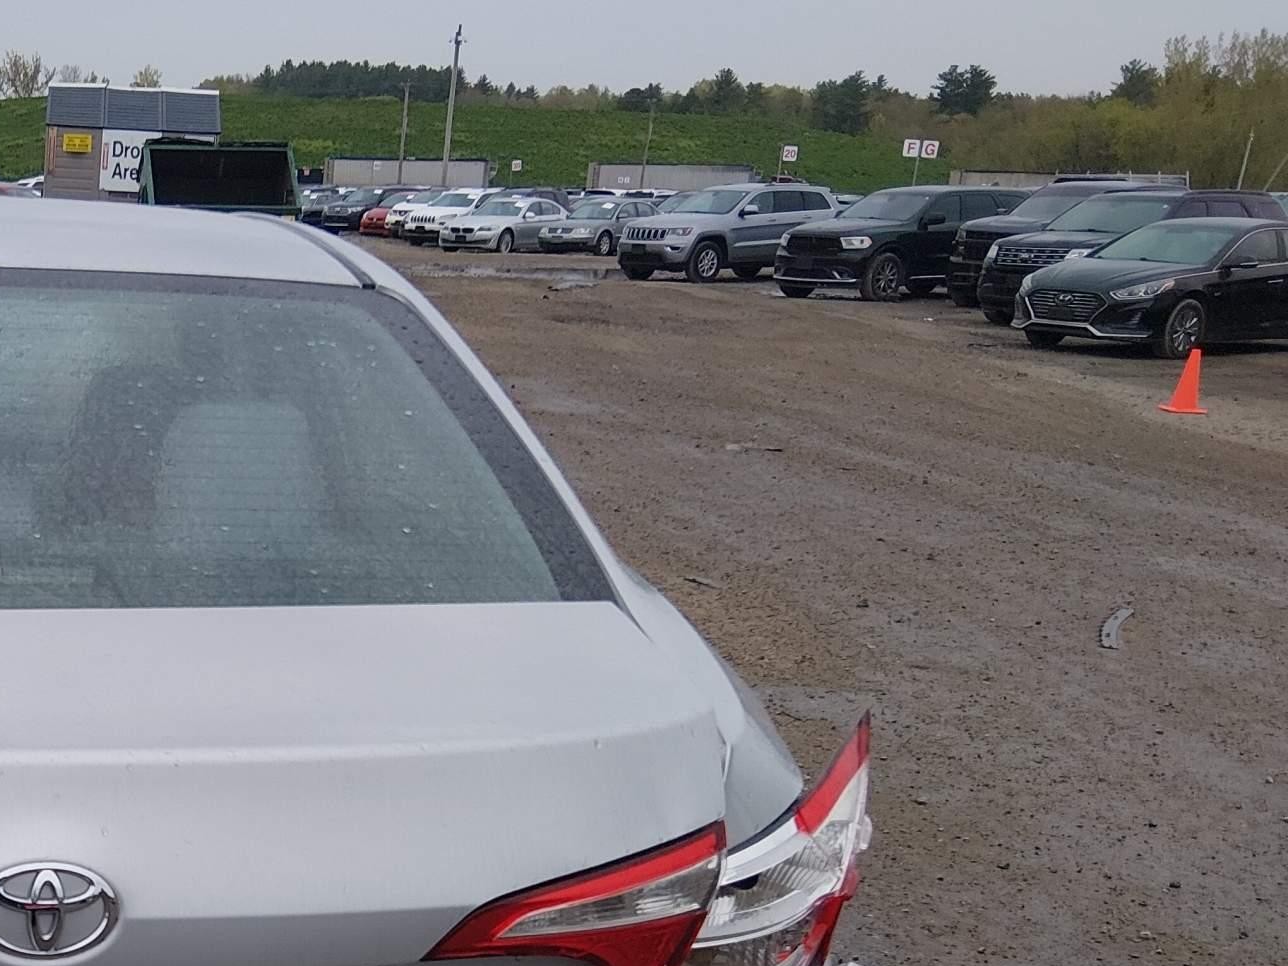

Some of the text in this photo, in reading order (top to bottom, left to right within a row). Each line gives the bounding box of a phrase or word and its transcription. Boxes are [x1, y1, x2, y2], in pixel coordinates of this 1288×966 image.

[112, 140, 141, 159] Dro
[784, 149, 797, 159] 20
[907, 142, 917, 155] F
[924, 143, 936, 156] G
[112, 162, 139, 181] Are
